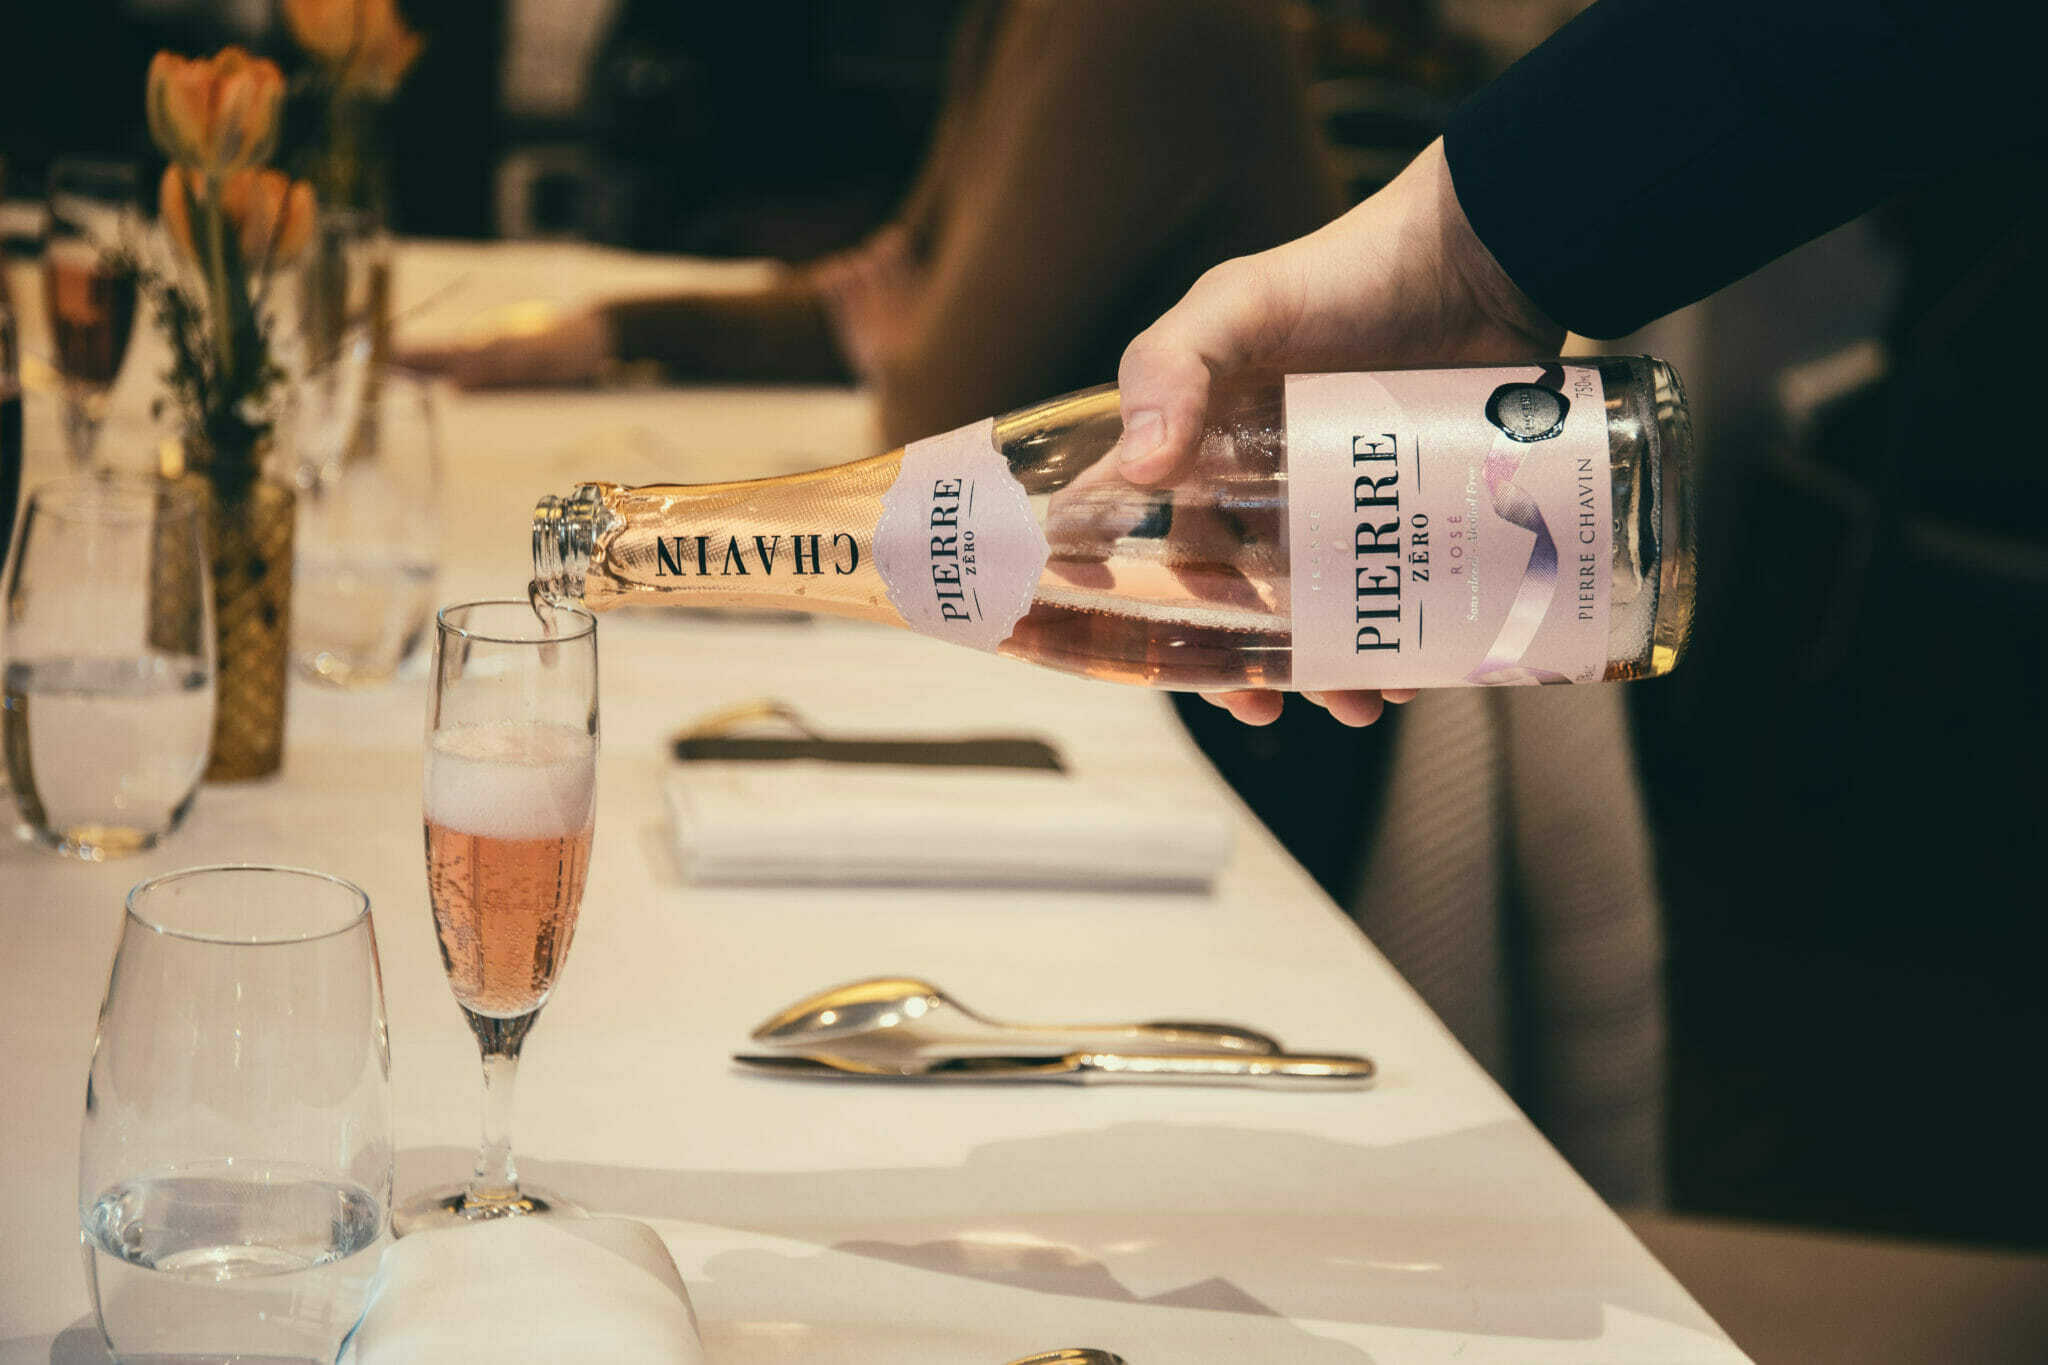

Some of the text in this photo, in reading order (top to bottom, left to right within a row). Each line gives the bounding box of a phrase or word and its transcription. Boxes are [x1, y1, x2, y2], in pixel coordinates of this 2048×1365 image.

[656, 532, 860, 575] CHAVIN
[930, 478, 971, 622] PIERRE
[1352, 432, 1401, 654] PIERRE
[1447, 514, 1463, 575] ROSÉ
[1576, 458, 1596, 620] PIERRE CHAVIN
